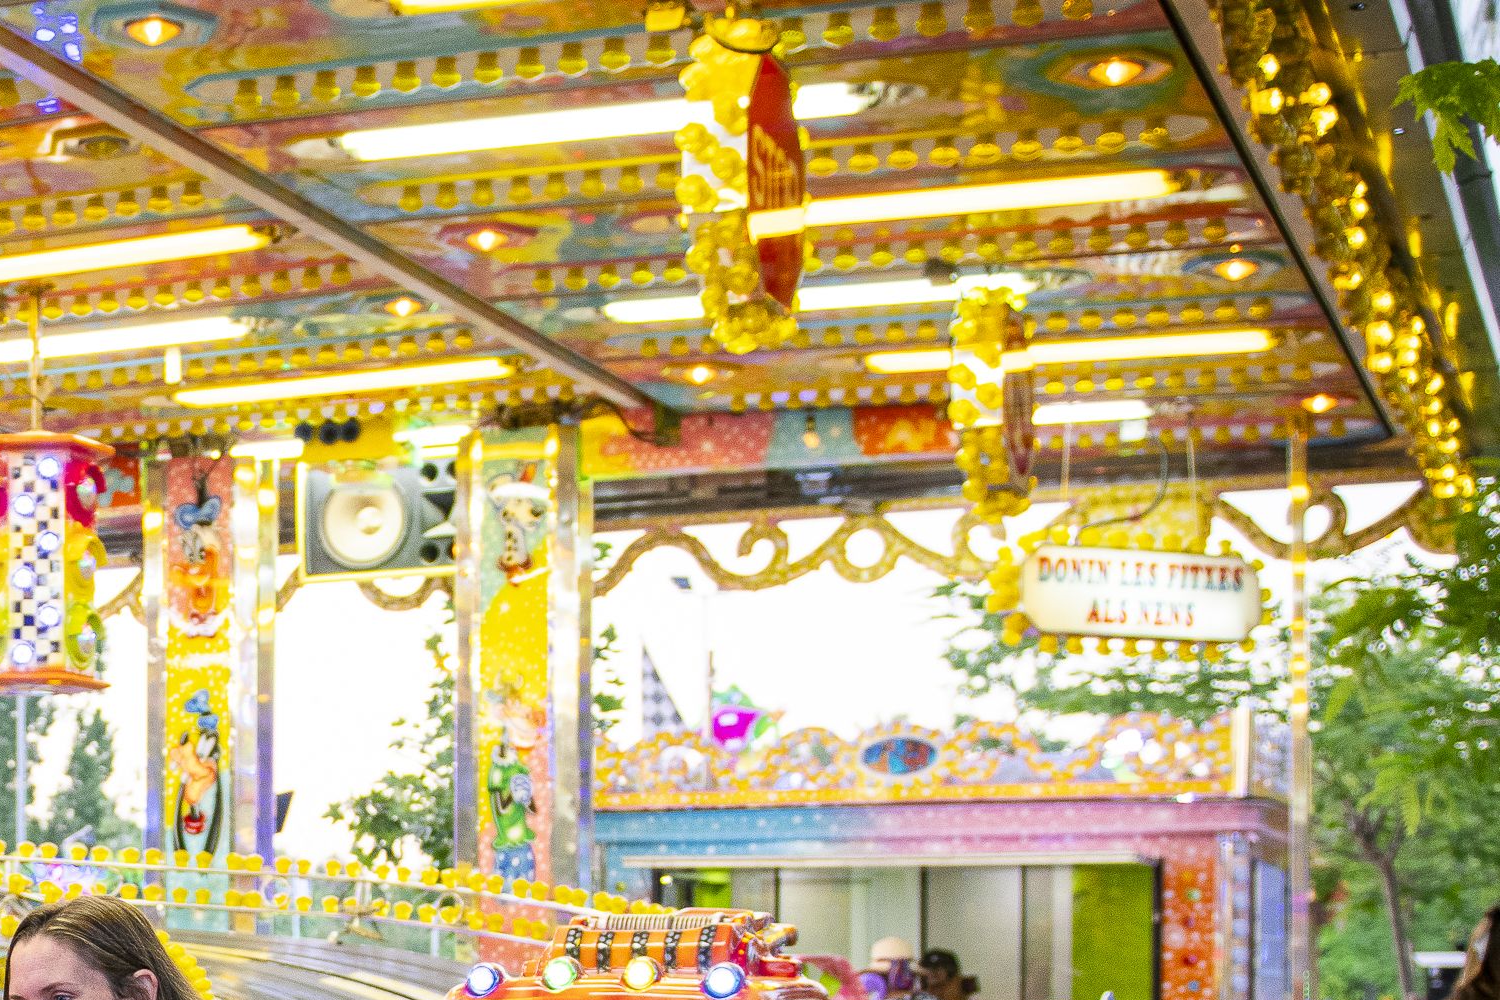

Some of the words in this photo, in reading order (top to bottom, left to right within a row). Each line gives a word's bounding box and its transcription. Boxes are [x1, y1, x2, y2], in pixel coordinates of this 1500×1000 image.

[1038, 556, 1109, 585] DONIN
[1120, 560, 1158, 587] LES
[1086, 598, 1128, 624] ALS
[1138, 600, 1195, 627] NENS
